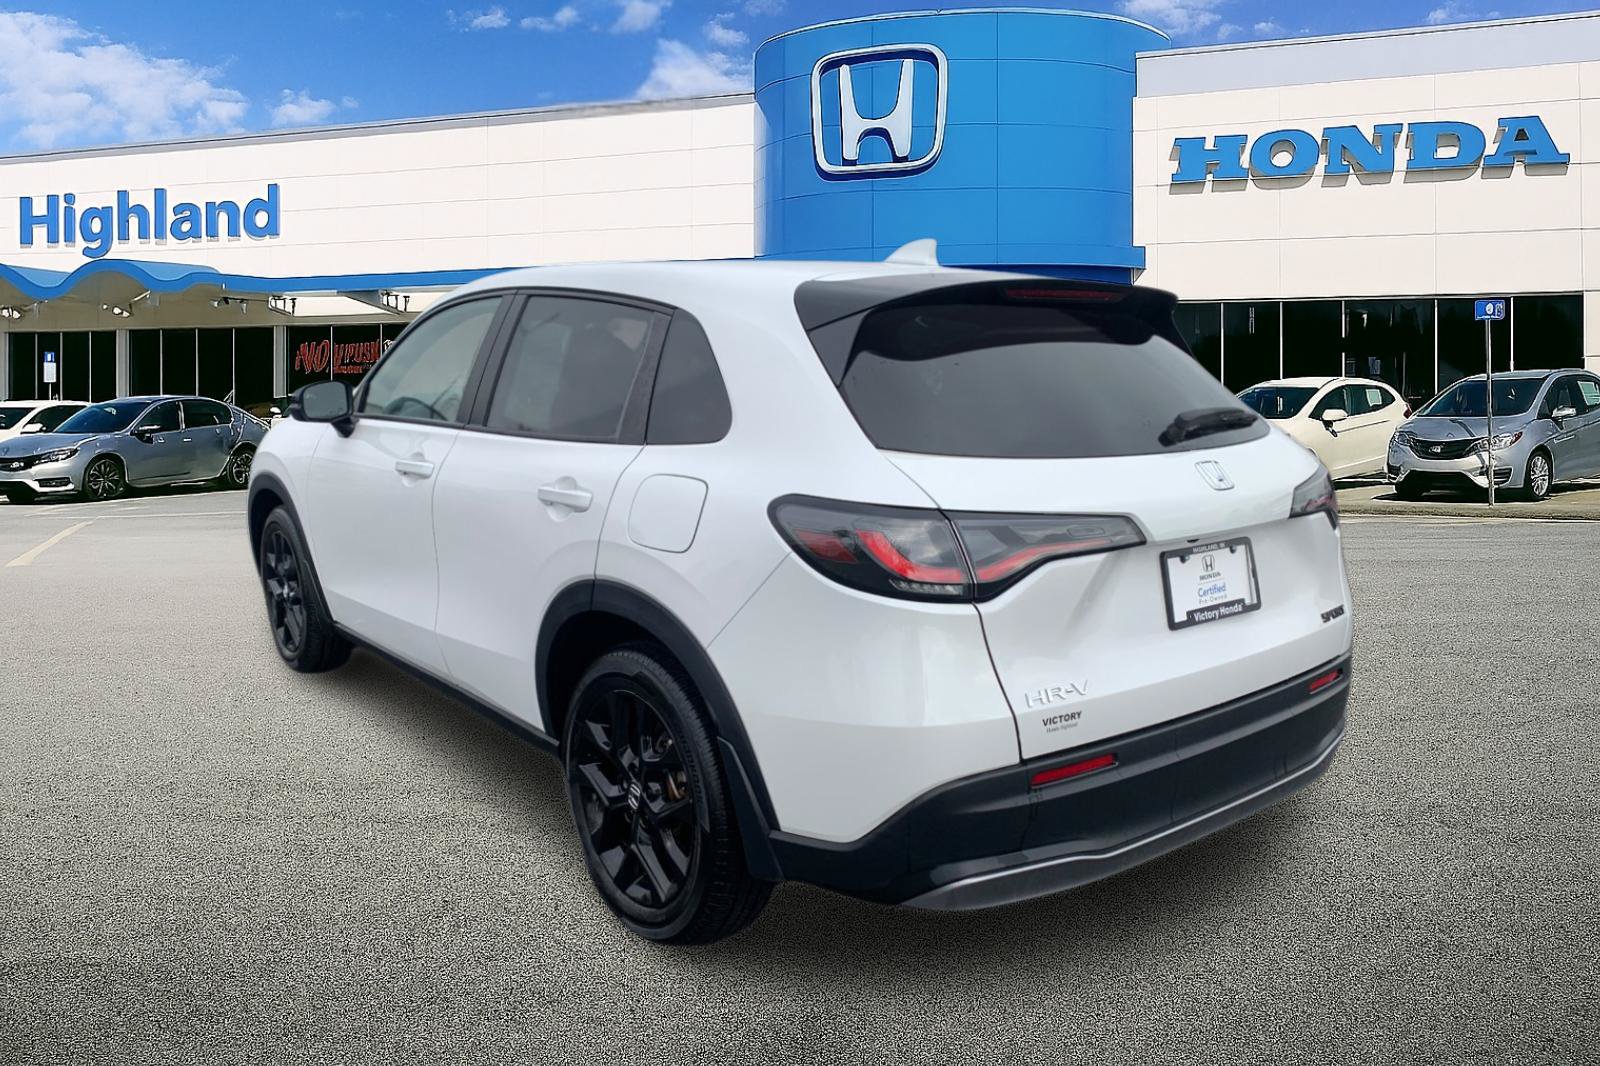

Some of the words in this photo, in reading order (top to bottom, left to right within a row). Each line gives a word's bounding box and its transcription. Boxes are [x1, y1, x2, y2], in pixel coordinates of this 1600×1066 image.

[1171, 115, 1570, 186] HONDA
[19, 183, 280, 259] Highland
[1199, 571, 1221, 581] HONDA
[1197, 582, 1227, 598] Certified
[1193, 609, 1219, 623] Victory
[1219, 603, 1243, 616] Honda
[1025, 679, 1089, 709] HR-V
[1042, 710, 1083, 727] VICTORY
